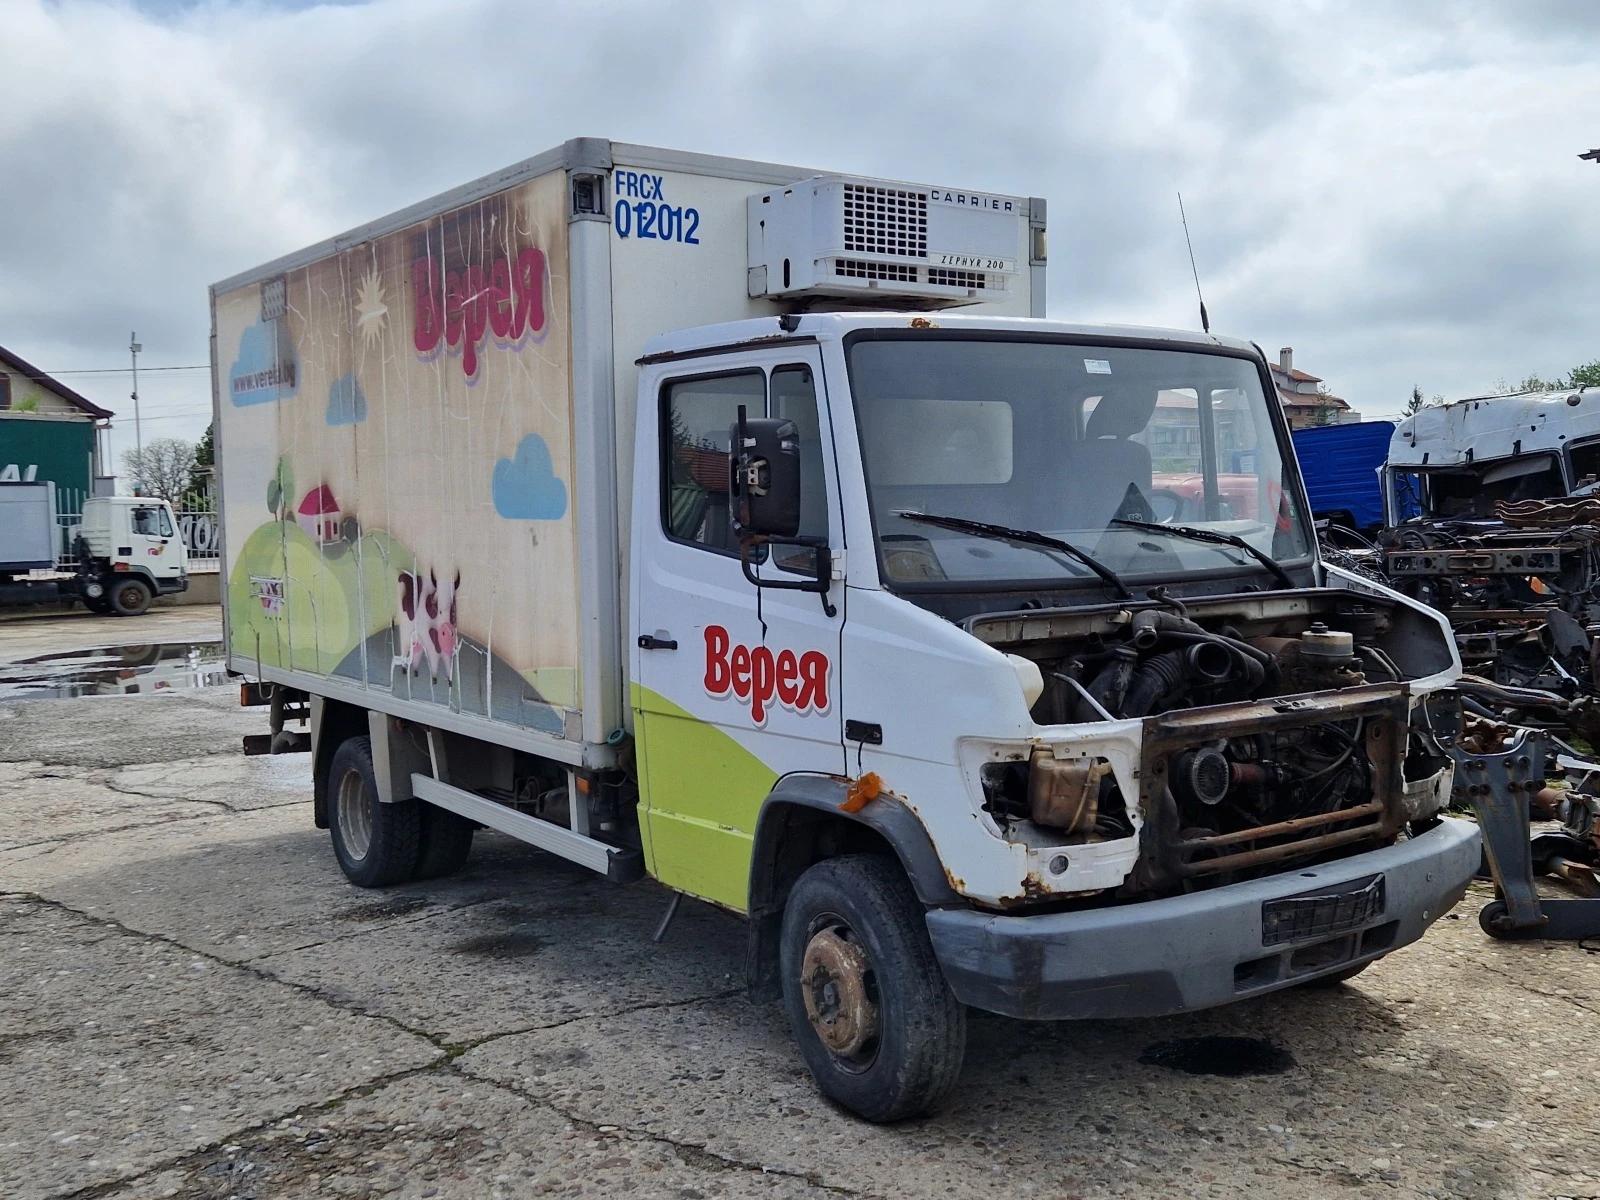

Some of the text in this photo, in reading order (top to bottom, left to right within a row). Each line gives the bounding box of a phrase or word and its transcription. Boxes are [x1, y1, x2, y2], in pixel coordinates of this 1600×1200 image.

[615, 170, 663, 201] FRCX
[931, 190, 1013, 211] CARRIER
[615, 199, 700, 245] 012012
[941, 255, 1004, 270] ZEPHYR 200
[414, 247, 547, 378] Верея
[703, 624, 830, 724] Верея
